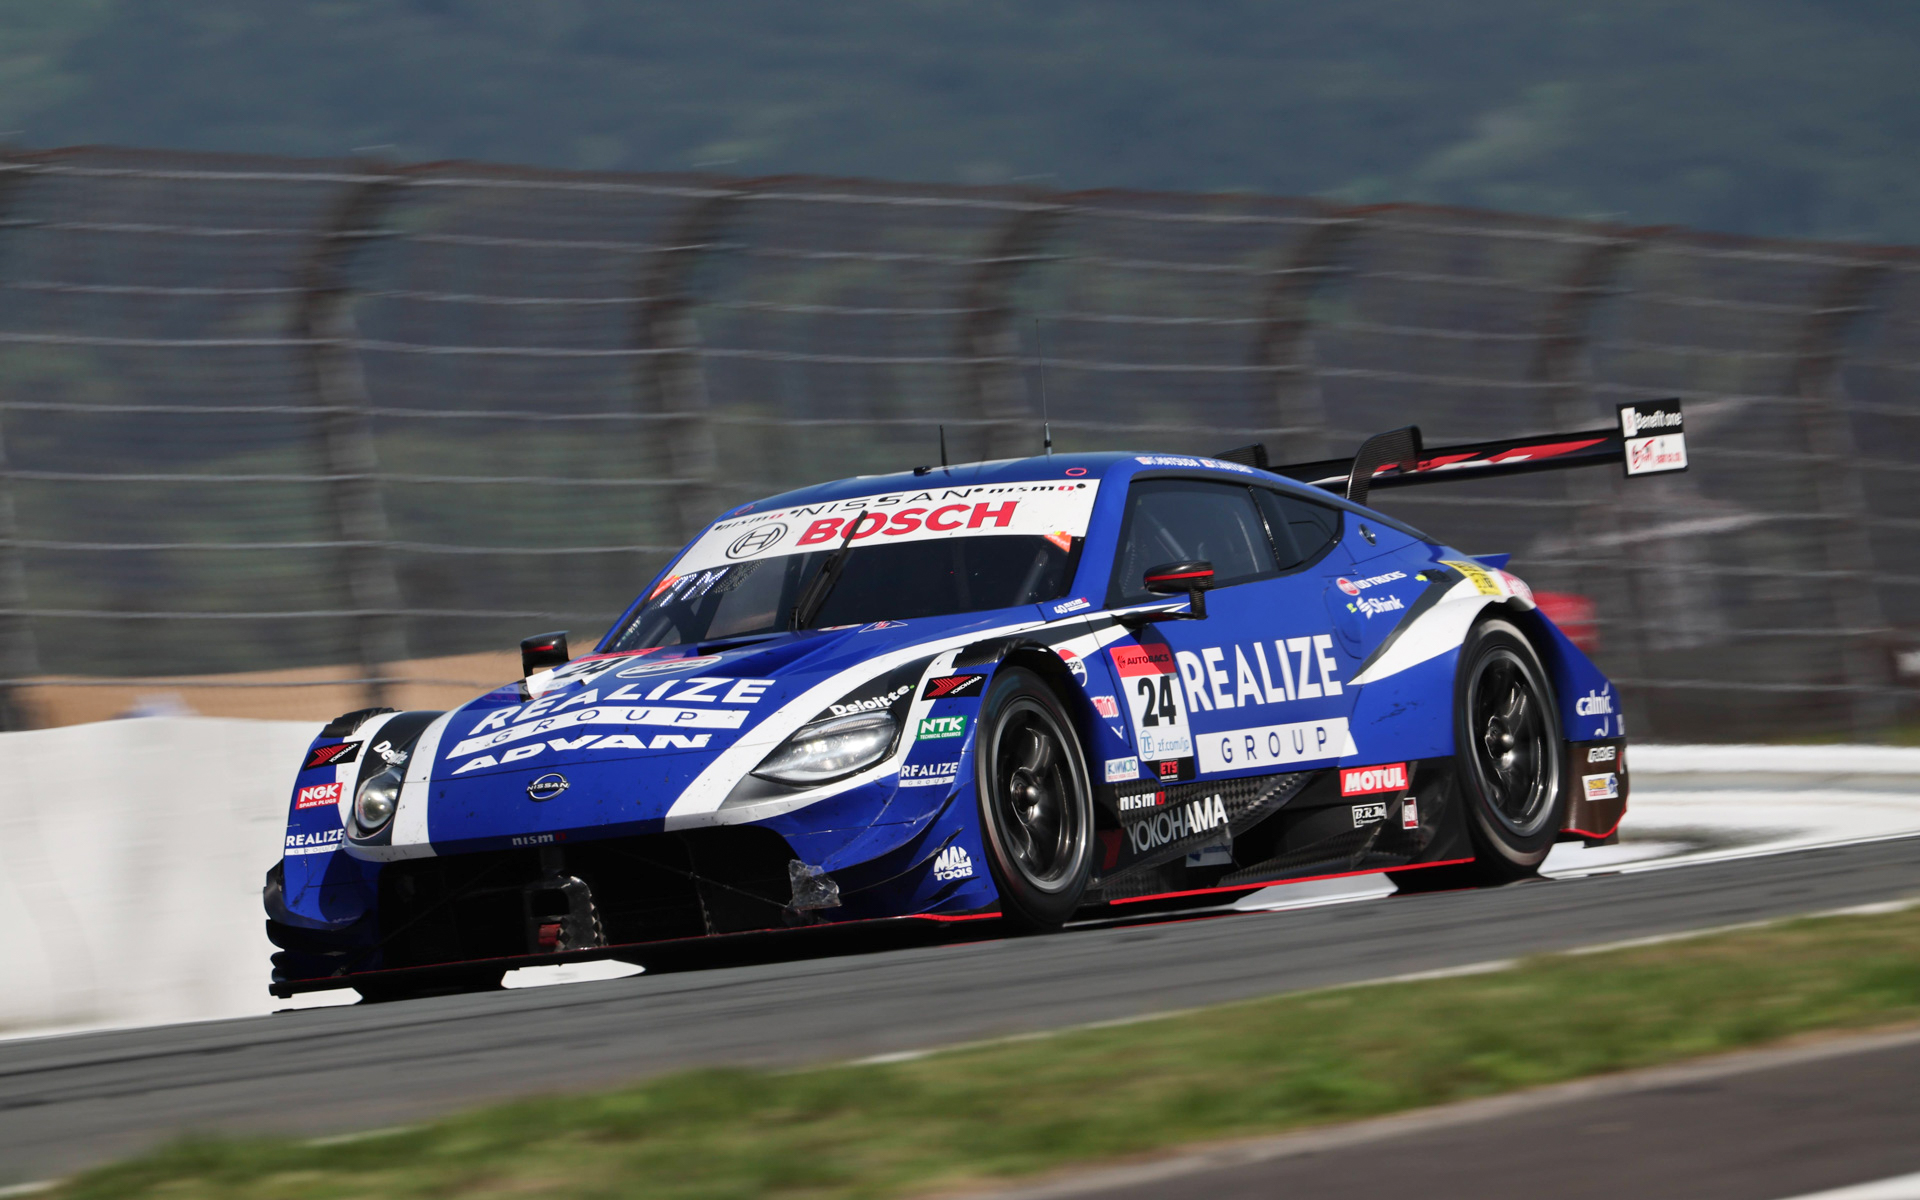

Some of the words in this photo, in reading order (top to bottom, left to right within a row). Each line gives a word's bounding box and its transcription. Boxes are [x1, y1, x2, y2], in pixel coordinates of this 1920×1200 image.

[988, 485, 1075, 494] nismo
[795, 488, 972, 518] NISSAN
[717, 512, 785, 531] nismo
[795, 501, 1020, 546] BOSCH
[1127, 654, 1170, 666] AUTOBACS
[1175, 634, 1343, 713] REALIZE
[950, 676, 983, 695] YOKOHAMA
[468, 678, 776, 736] REALIZE
[1137, 675, 1177, 728] 24
[492, 709, 698, 744] GROUP
[920, 717, 964, 734] NTK
[920, 732, 941, 740] TECHNICAL
[1221, 726, 1327, 763] GROUP
[328, 743, 358, 763] YOKOHAMA
[451, 734, 713, 776] ADVAN
[901, 762, 959, 777] REALIZE
[1160, 761, 1178, 775] ETS
[526, 782, 570, 792] NISSAN
[908, 777, 947, 786] GROUP
[1344, 766, 1405, 793] MOTUL
[300, 784, 340, 803] NGK
[1119, 791, 1166, 811] nismo
[299, 800, 318, 809] SPARK
[318, 798, 337, 806] PLUGS
[1127, 794, 1230, 855] YOKOHAMA
[285, 828, 345, 847] REALIZE
[512, 832, 568, 846] nismo
[934, 866, 973, 881] TOOLS
